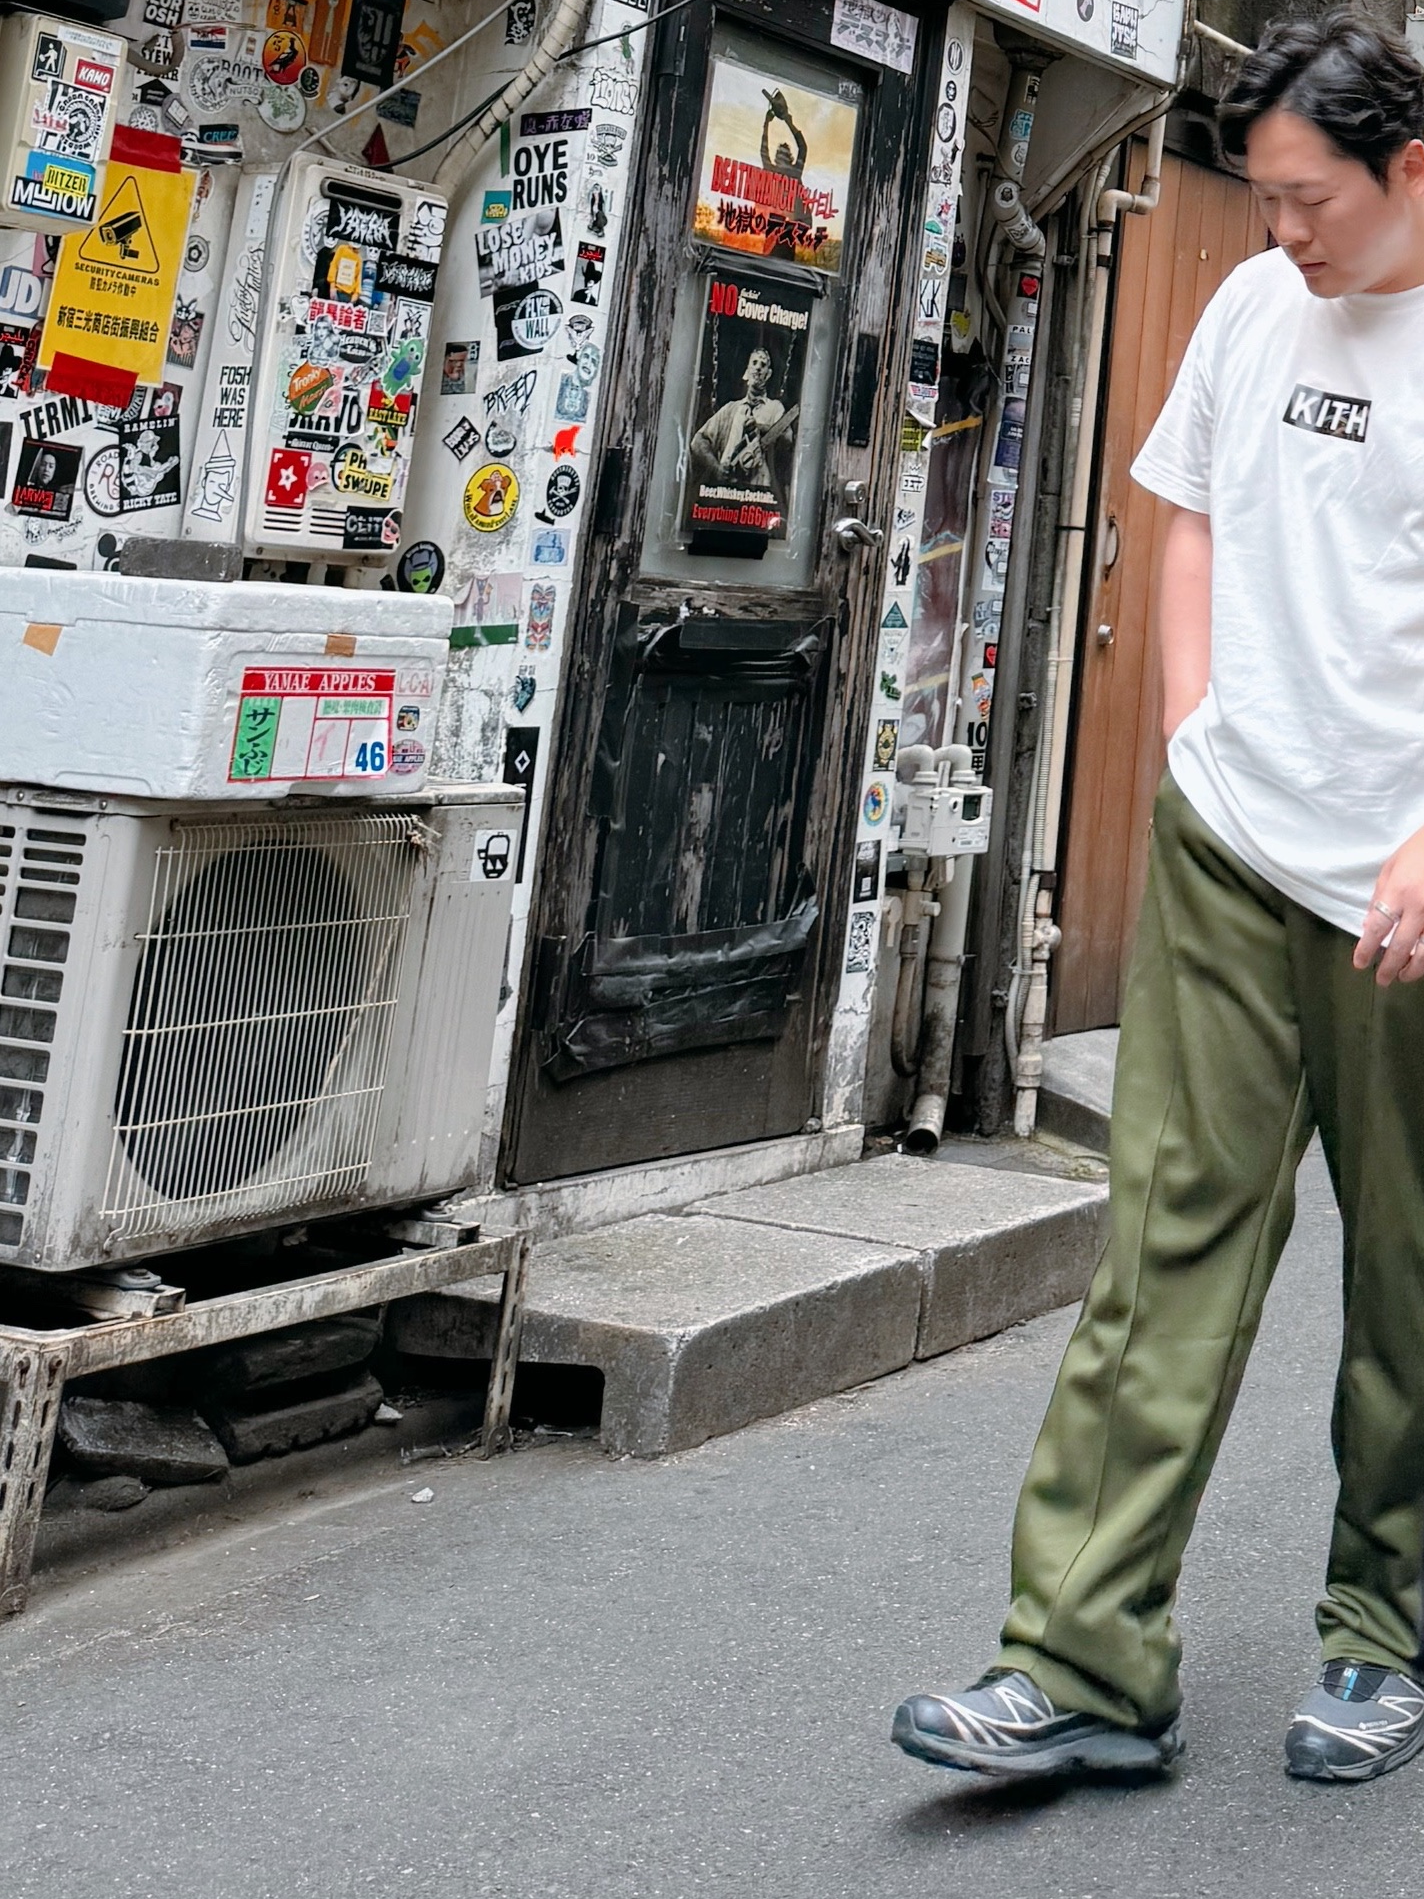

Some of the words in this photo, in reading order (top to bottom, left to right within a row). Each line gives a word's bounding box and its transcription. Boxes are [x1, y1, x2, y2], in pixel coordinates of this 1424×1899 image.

[514, 139, 568, 177] OYE
[512, 171, 568, 210] RUNS
[477, 222, 526, 256] LOSE
[717, 197, 829, 252] 地獄のデスマッチ
[491, 232, 559, 275] MONEY
[75, 262, 116, 280] SECURITY
[116, 270, 160, 287] CAMERAS
[710, 281, 738, 317] NO
[737, 299, 769, 321] Cover
[770, 303, 809, 330] Charge!
[525, 318, 549, 340] WALL
[220, 388, 246, 406] WAS
[123, 416, 179, 433] RAMBLIN'
[213, 407, 245, 429] HERE
[1290, 390, 1370, 439] KITH
[692, 503, 738, 524] Everything
[264, 673, 310, 693] YAMAE
[318, 673, 376, 692] APPLES
[238, 706, 276, 778] サンふじ
[355, 740, 385, 772] 46
